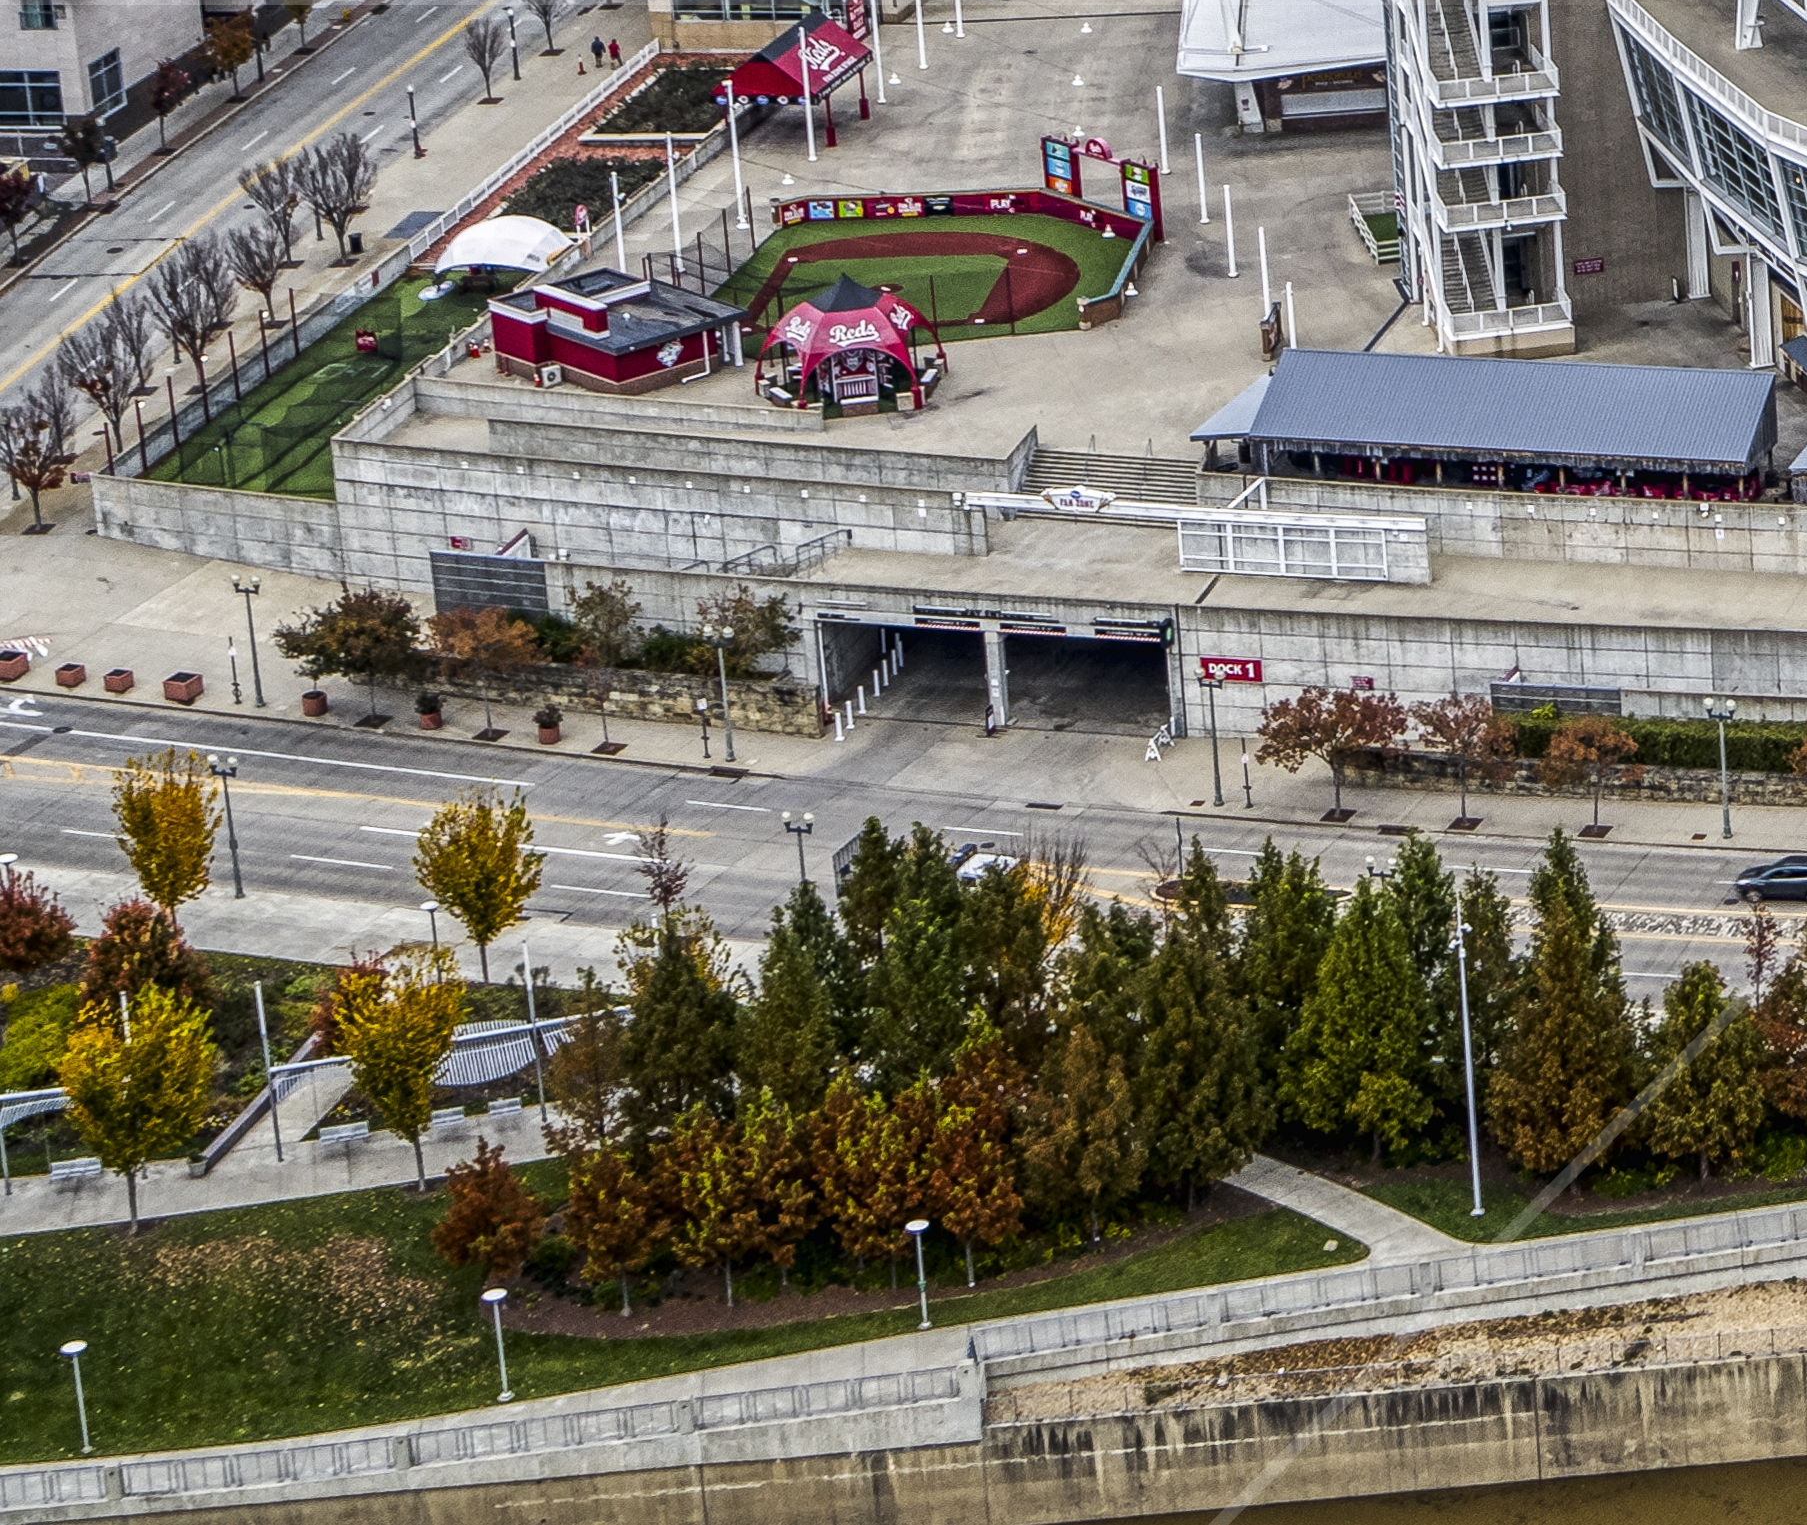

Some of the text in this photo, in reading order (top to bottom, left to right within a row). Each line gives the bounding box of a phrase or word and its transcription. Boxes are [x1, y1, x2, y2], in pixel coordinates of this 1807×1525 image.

[798, 36, 840, 71] Reds
[829, 321, 881, 347] Reds
[1060, 498, 1094, 508] FAN ZONE
[1208, 663, 1255, 678] DOCK 1
